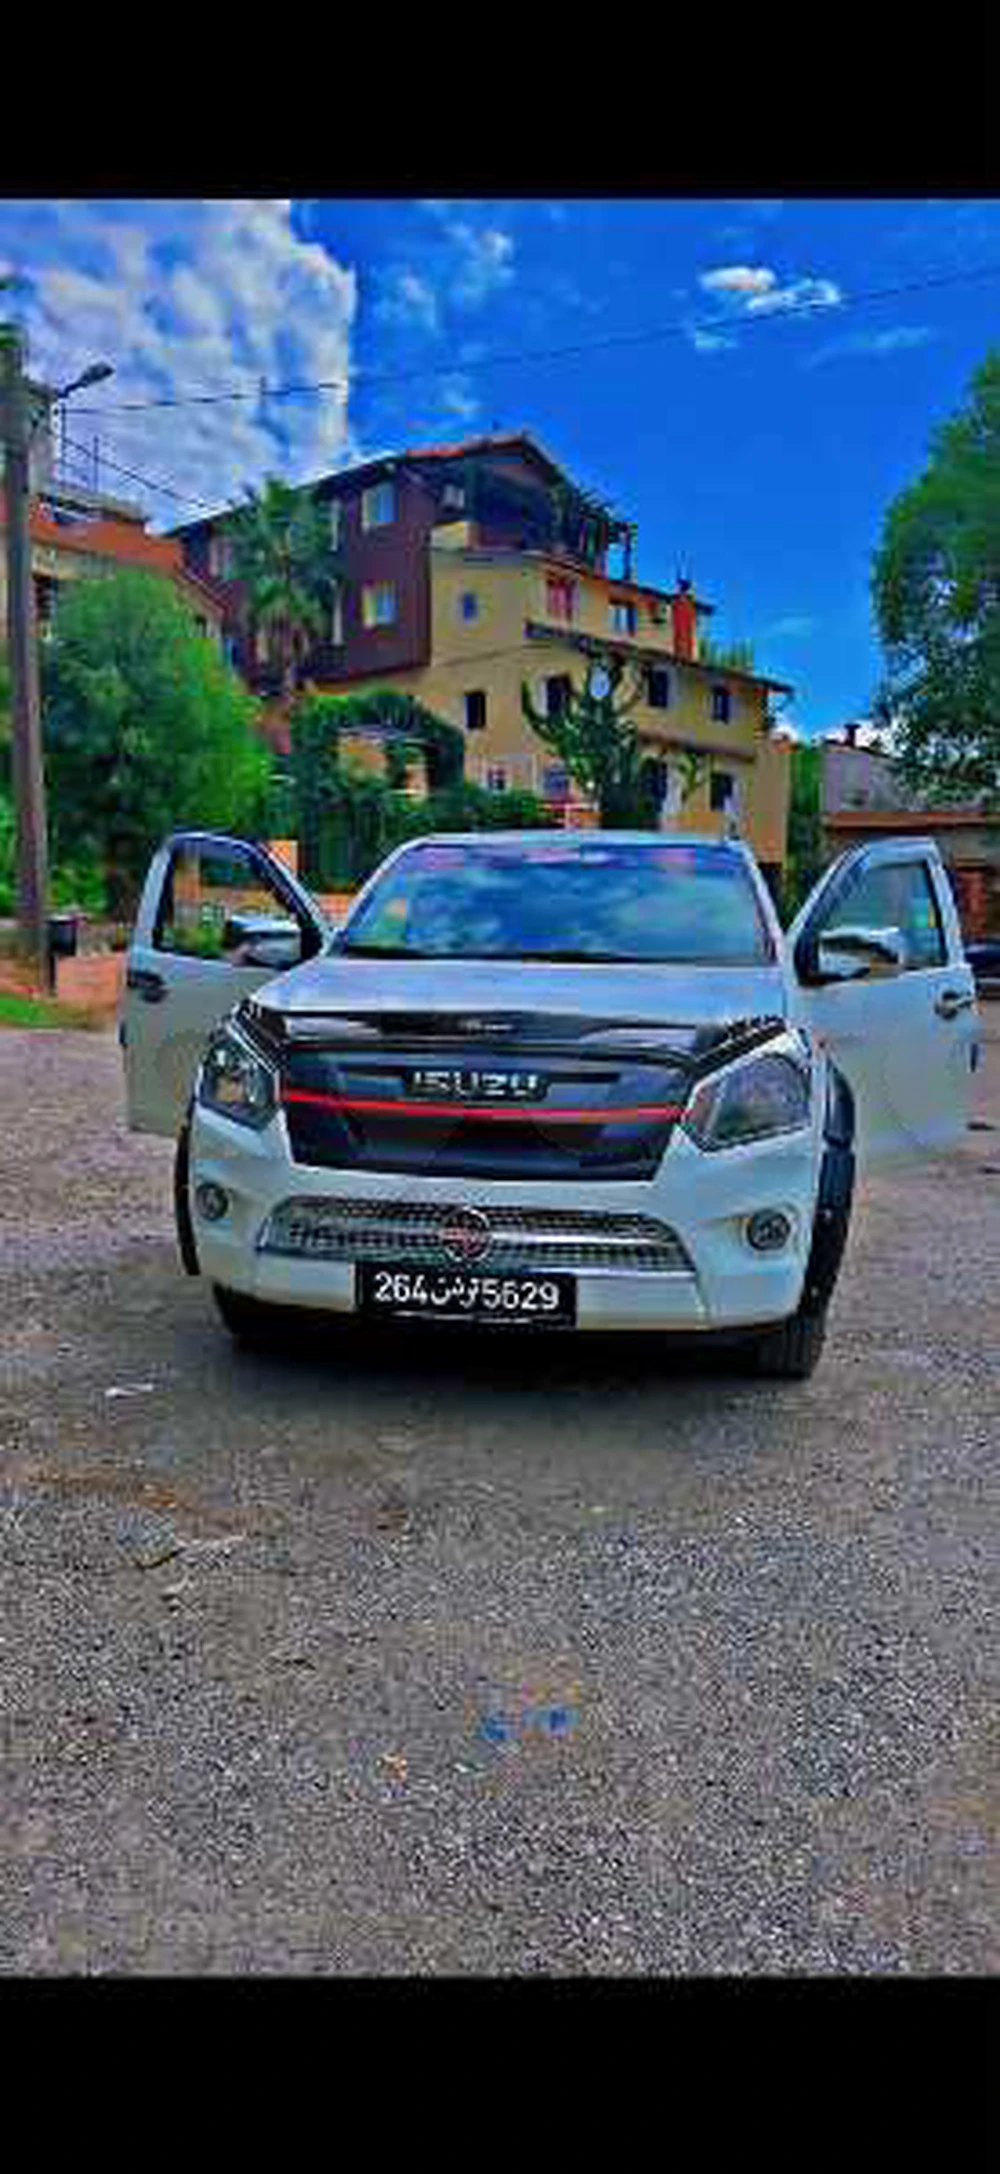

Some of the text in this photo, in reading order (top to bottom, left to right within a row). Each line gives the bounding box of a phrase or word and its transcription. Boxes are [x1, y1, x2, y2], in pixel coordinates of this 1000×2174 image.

[413, 1071, 539, 1097] ISUZU
[374, 1270, 429, 1305] 264
[481, 1277, 560, 1311] 5629
